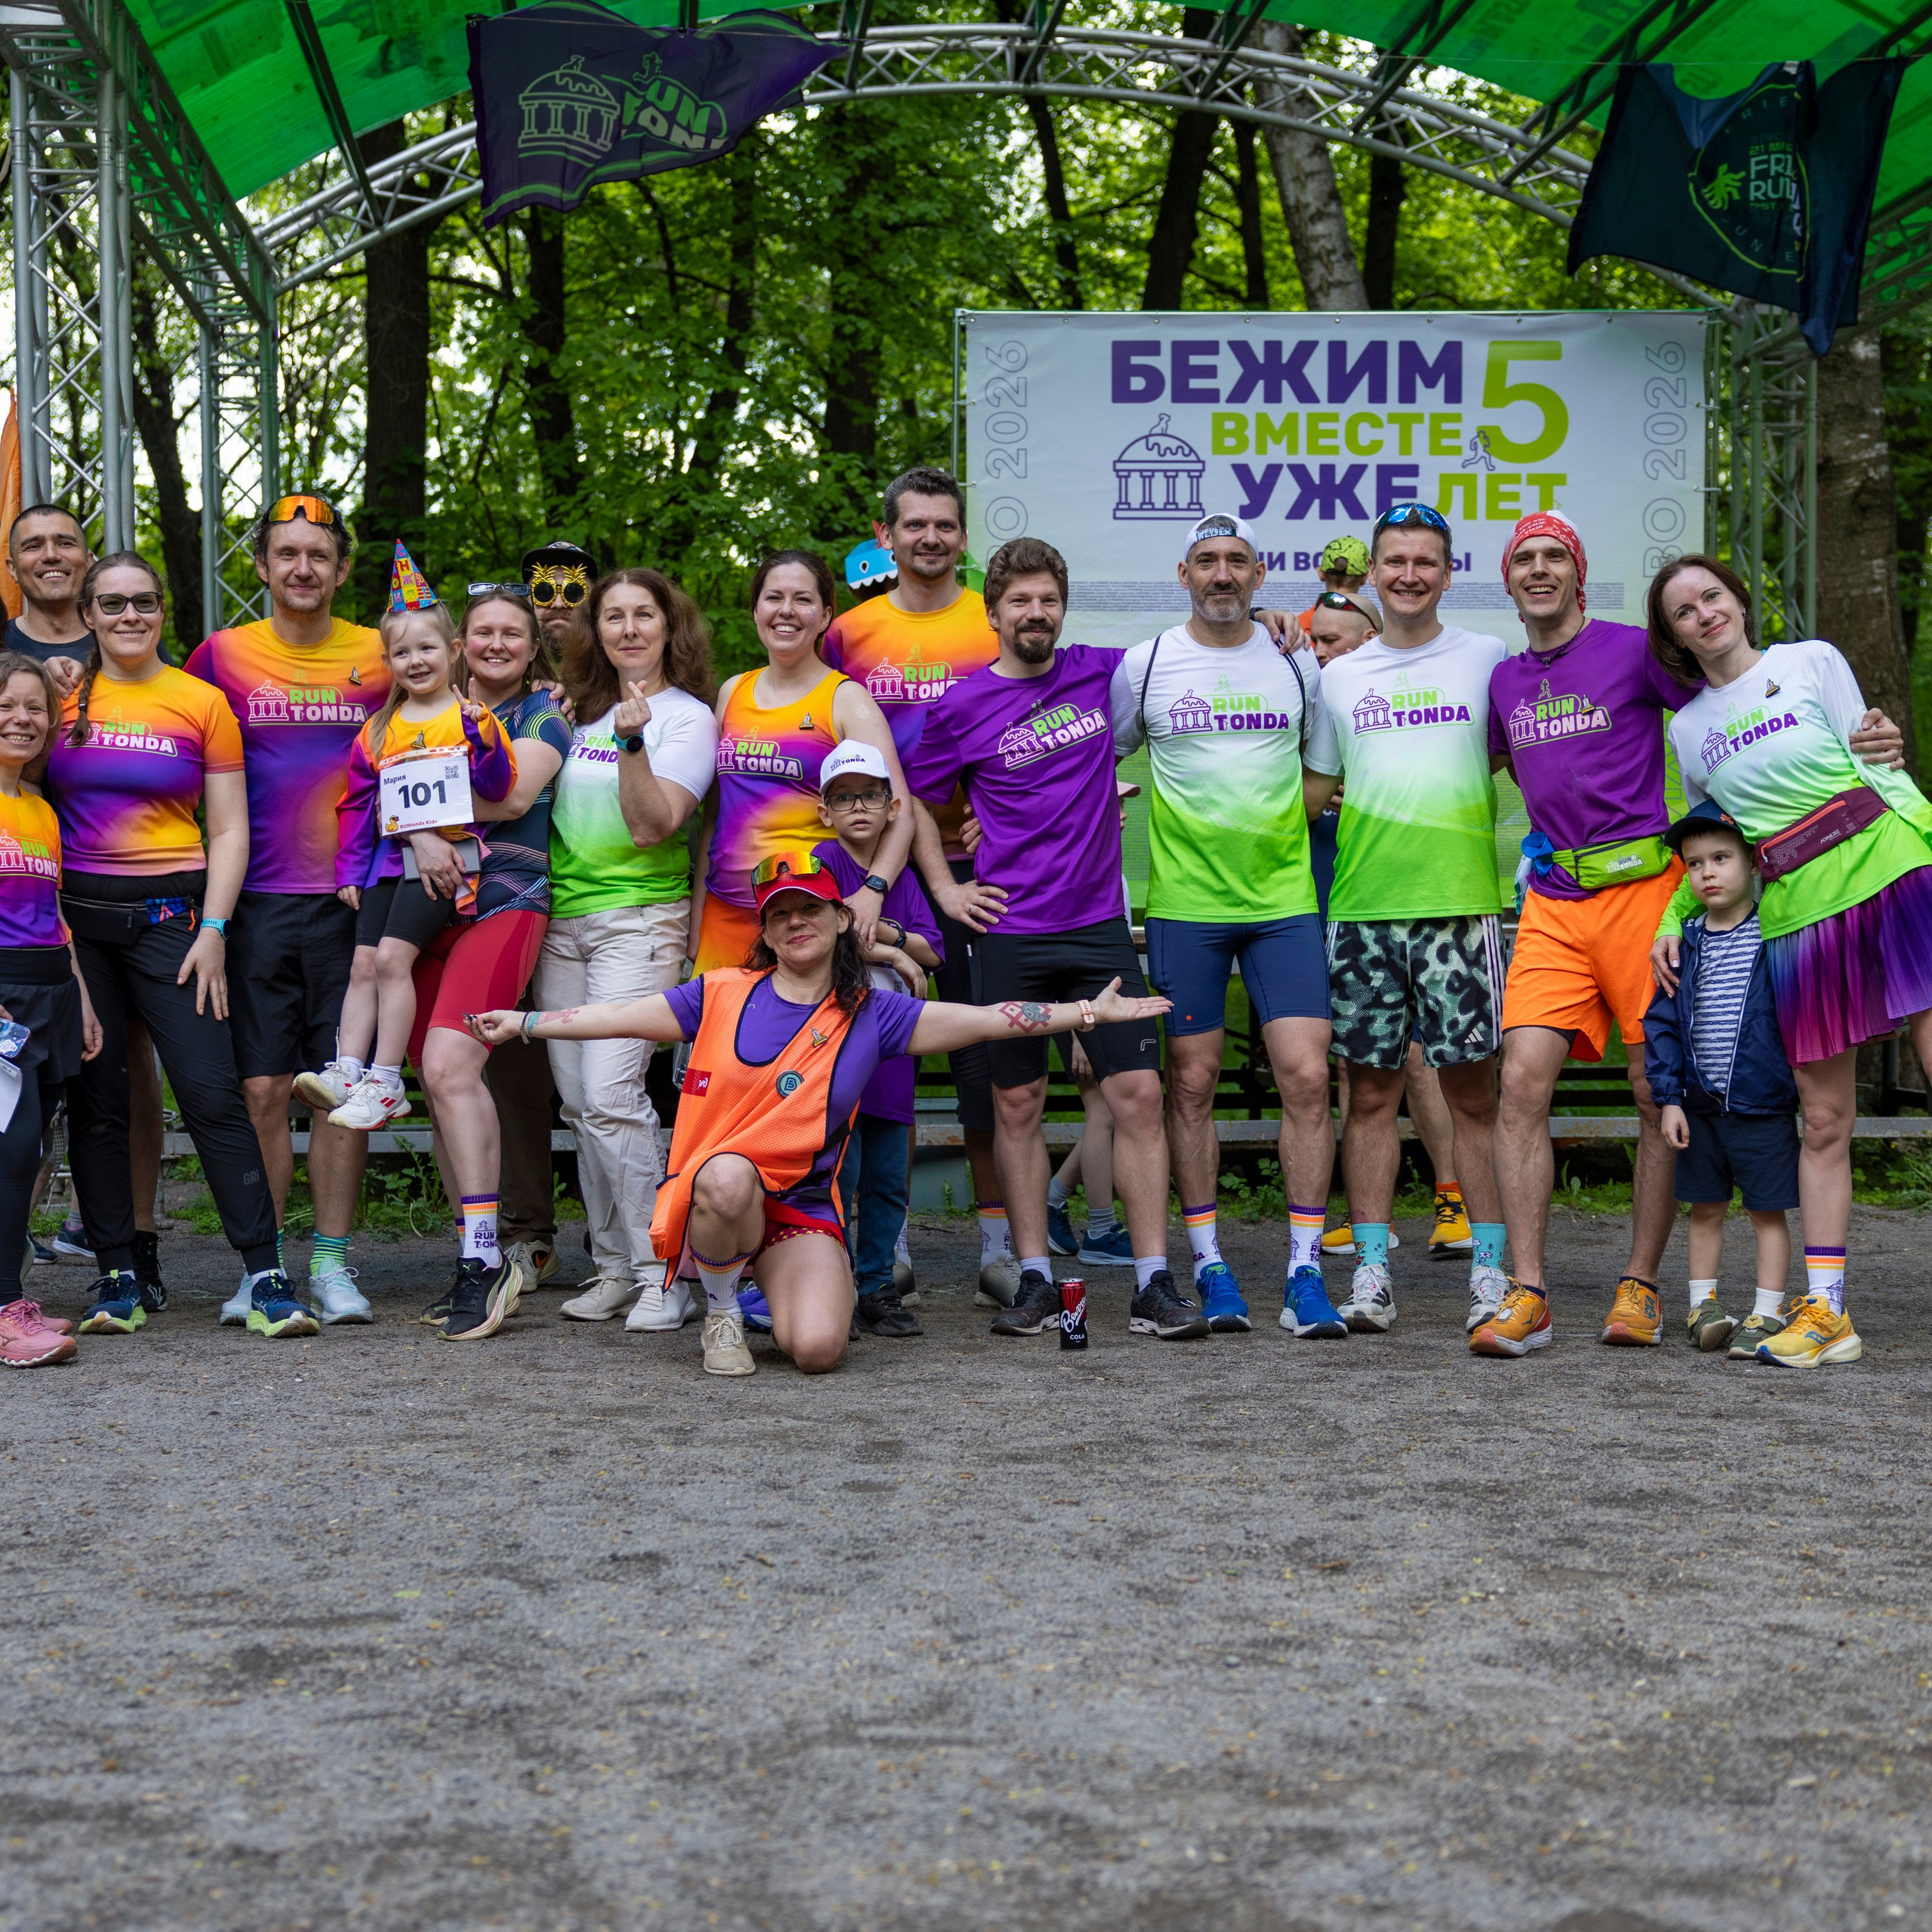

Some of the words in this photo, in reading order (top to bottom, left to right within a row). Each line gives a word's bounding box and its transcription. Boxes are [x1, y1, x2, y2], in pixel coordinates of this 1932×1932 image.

[1111, 340, 1463, 404] БЕЖИМ
[984, 340, 1029, 479] 2026
[1482, 340, 1570, 464] 5
[1644, 341, 1687, 481] 2026
[1212, 412, 1463, 456] ВМЕСТЕ
[1230, 463, 1420, 520] УЖЕ
[1434, 473, 1567, 521] ЛЕТ
[904, 664, 946, 682] RUN
[289, 689, 337, 704] RUN
[904, 680, 958, 700] TON
[1392, 690, 1438, 710] RUN
[290, 705, 366, 722] TONDA
[1212, 696, 1261, 713] RUN
[1536, 697, 1575, 721] RUN
[1032, 706, 1077, 737] RUN
[1214, 712, 1289, 731] TONDA
[1392, 705, 1471, 728] TONDA
[1536, 709, 1607, 739] TONDA
[1725, 708, 1764, 740] RUN
[103, 721, 146, 736] RUN
[1041, 711, 1106, 750] TONDA
[1729, 712, 1799, 752] TONDA
[101, 734, 174, 754] TONDA
[584, 735, 616, 749] RUN
[735, 741, 775, 757] RUN
[577, 746, 619, 763] TOND
[734, 755, 799, 777] TONDA
[383, 774, 407, 786] Мария
[398, 780, 447, 809] 101
[21, 840, 51, 859] RUN
[24, 856, 58, 878] TOND
[1618, 857, 1632, 866] RUN
[1619, 858, 1644, 870] TONDA
[474, 1231, 495, 1240] RUN
[474, 1240, 498, 1249] TON
